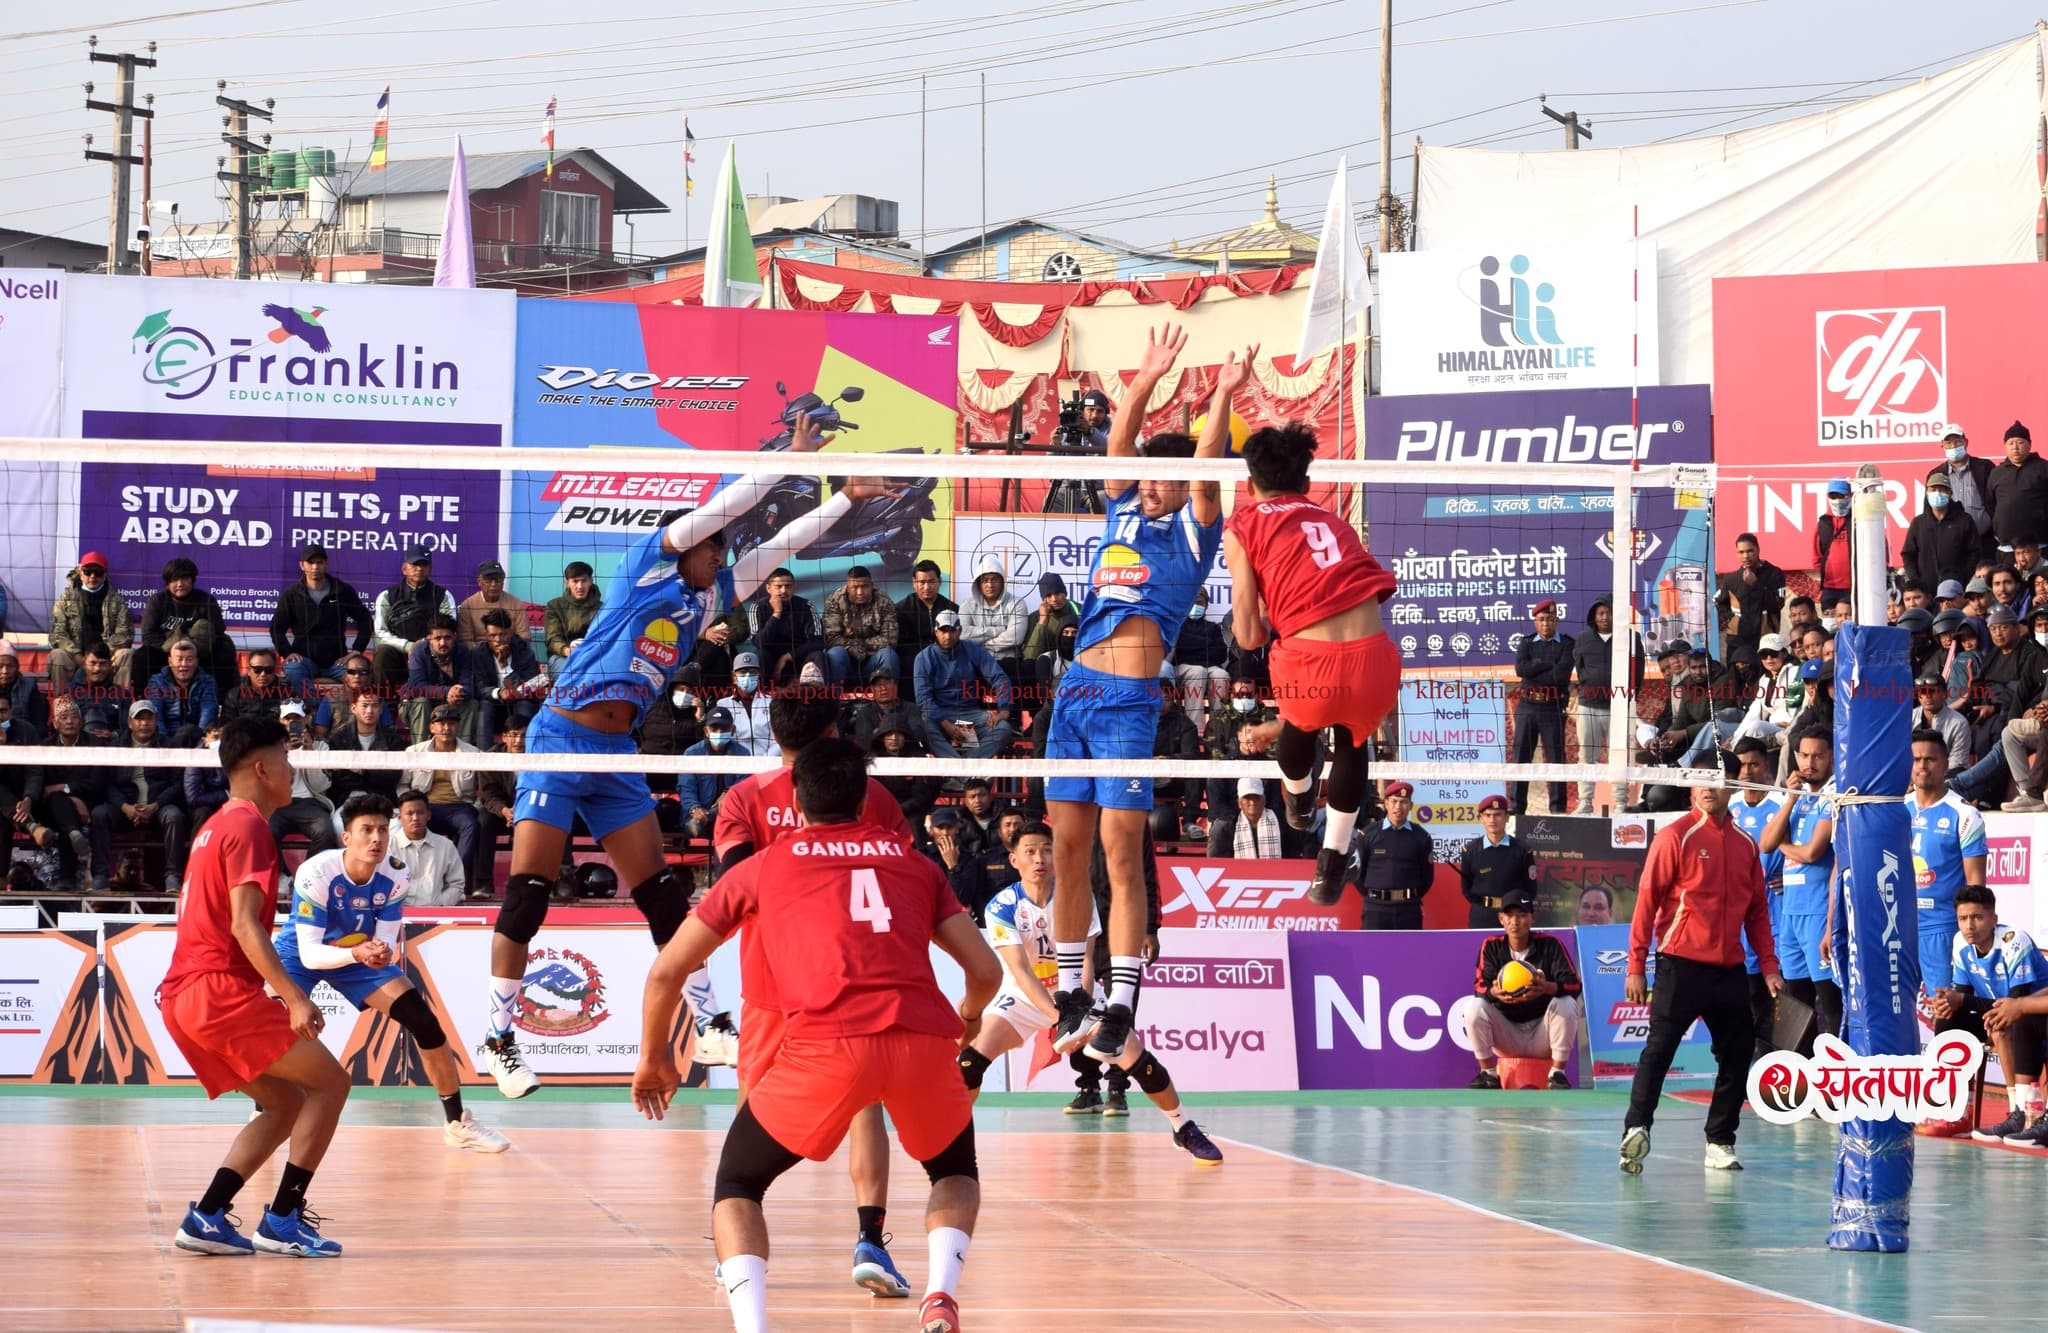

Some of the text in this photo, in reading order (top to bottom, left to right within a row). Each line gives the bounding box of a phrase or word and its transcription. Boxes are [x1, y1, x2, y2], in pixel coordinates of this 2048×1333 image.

[0, 278, 58, 300] Ncell
[229, 338, 458, 390] Franklin
[660, 376, 750, 390] 125
[229, 389, 458, 408] EDUCATION CONSULTANCY
[538, 393, 739, 411] MAKE THE SMART CHOICE
[1821, 418, 1944, 441] DishHome
[551, 474, 710, 499] MILEAGE
[121, 485, 240, 515] STUDY
[292, 491, 460, 525] IELTS, PTE
[564, 506, 682, 529] POWE
[120, 516, 274, 547] ABROAD
[1115, 515, 1141, 544] 14
[292, 528, 458, 554] PREPERATION
[1300, 521, 1342, 570] 9
[1100, 568, 1144, 583] tip top
[118, 588, 143, 598] Head
[210, 587, 280, 598] Pokhara Branch
[1391, 578, 1566, 599] PLUMBER PIPES & FITTINGS
[640, 641, 673, 662] tip top
[1436, 708, 1469, 720] Ncell
[1409, 729, 1496, 744] UNLIMITED
[1439, 789, 1469, 799] Rs. 50
[792, 840, 903, 857] GANDAKI
[850, 868, 893, 934] 4
[1161, 866, 1312, 915] XTEP
[1196, 914, 1340, 932] FASHION SPORTS
[1214, 960, 1275, 985] लागि
[994, 993, 1016, 1011] 12
[1132, 1022, 1265, 1060] atsalya
